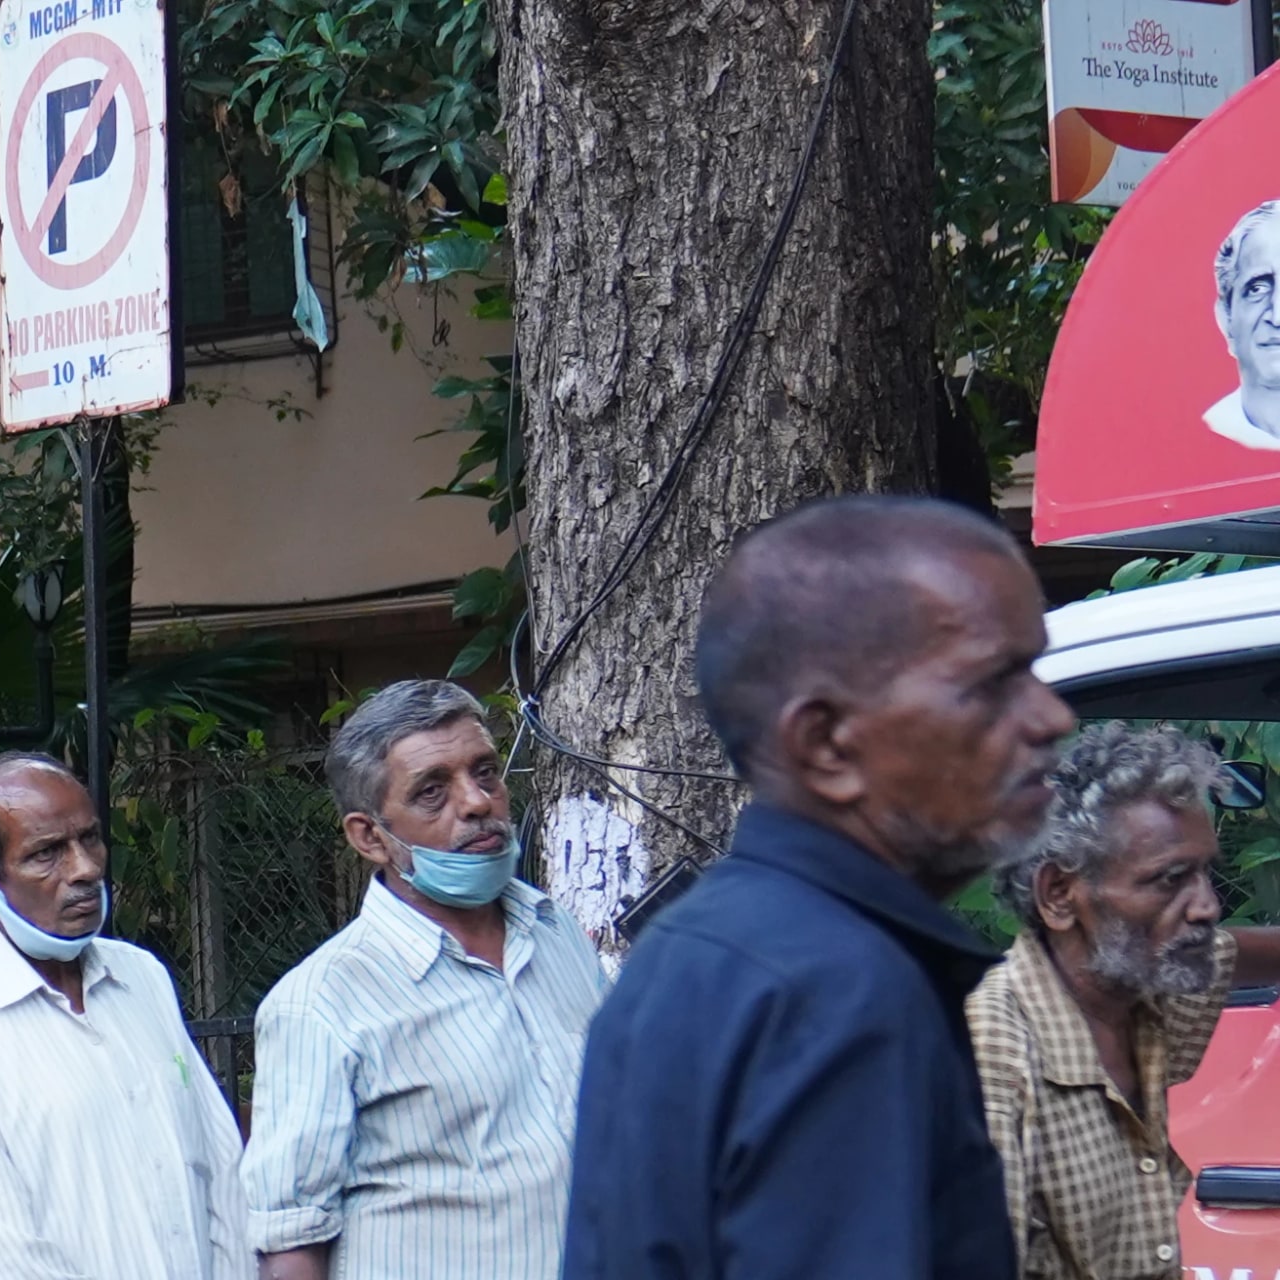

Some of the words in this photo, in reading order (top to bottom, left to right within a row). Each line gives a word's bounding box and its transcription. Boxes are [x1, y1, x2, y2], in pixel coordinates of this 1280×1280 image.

[28, 0, 77, 40] MCGM
[1082, 57, 1112, 79] The
[1114, 60, 1151, 88] Yoga
[1152, 64, 1219, 89] Institute
[9, 317, 29, 358] NO
[33, 300, 110, 354] PARKING
[114, 291, 162, 337] ZONE
[53, 360, 75, 387] 10
[89, 353, 112, 380] M.
